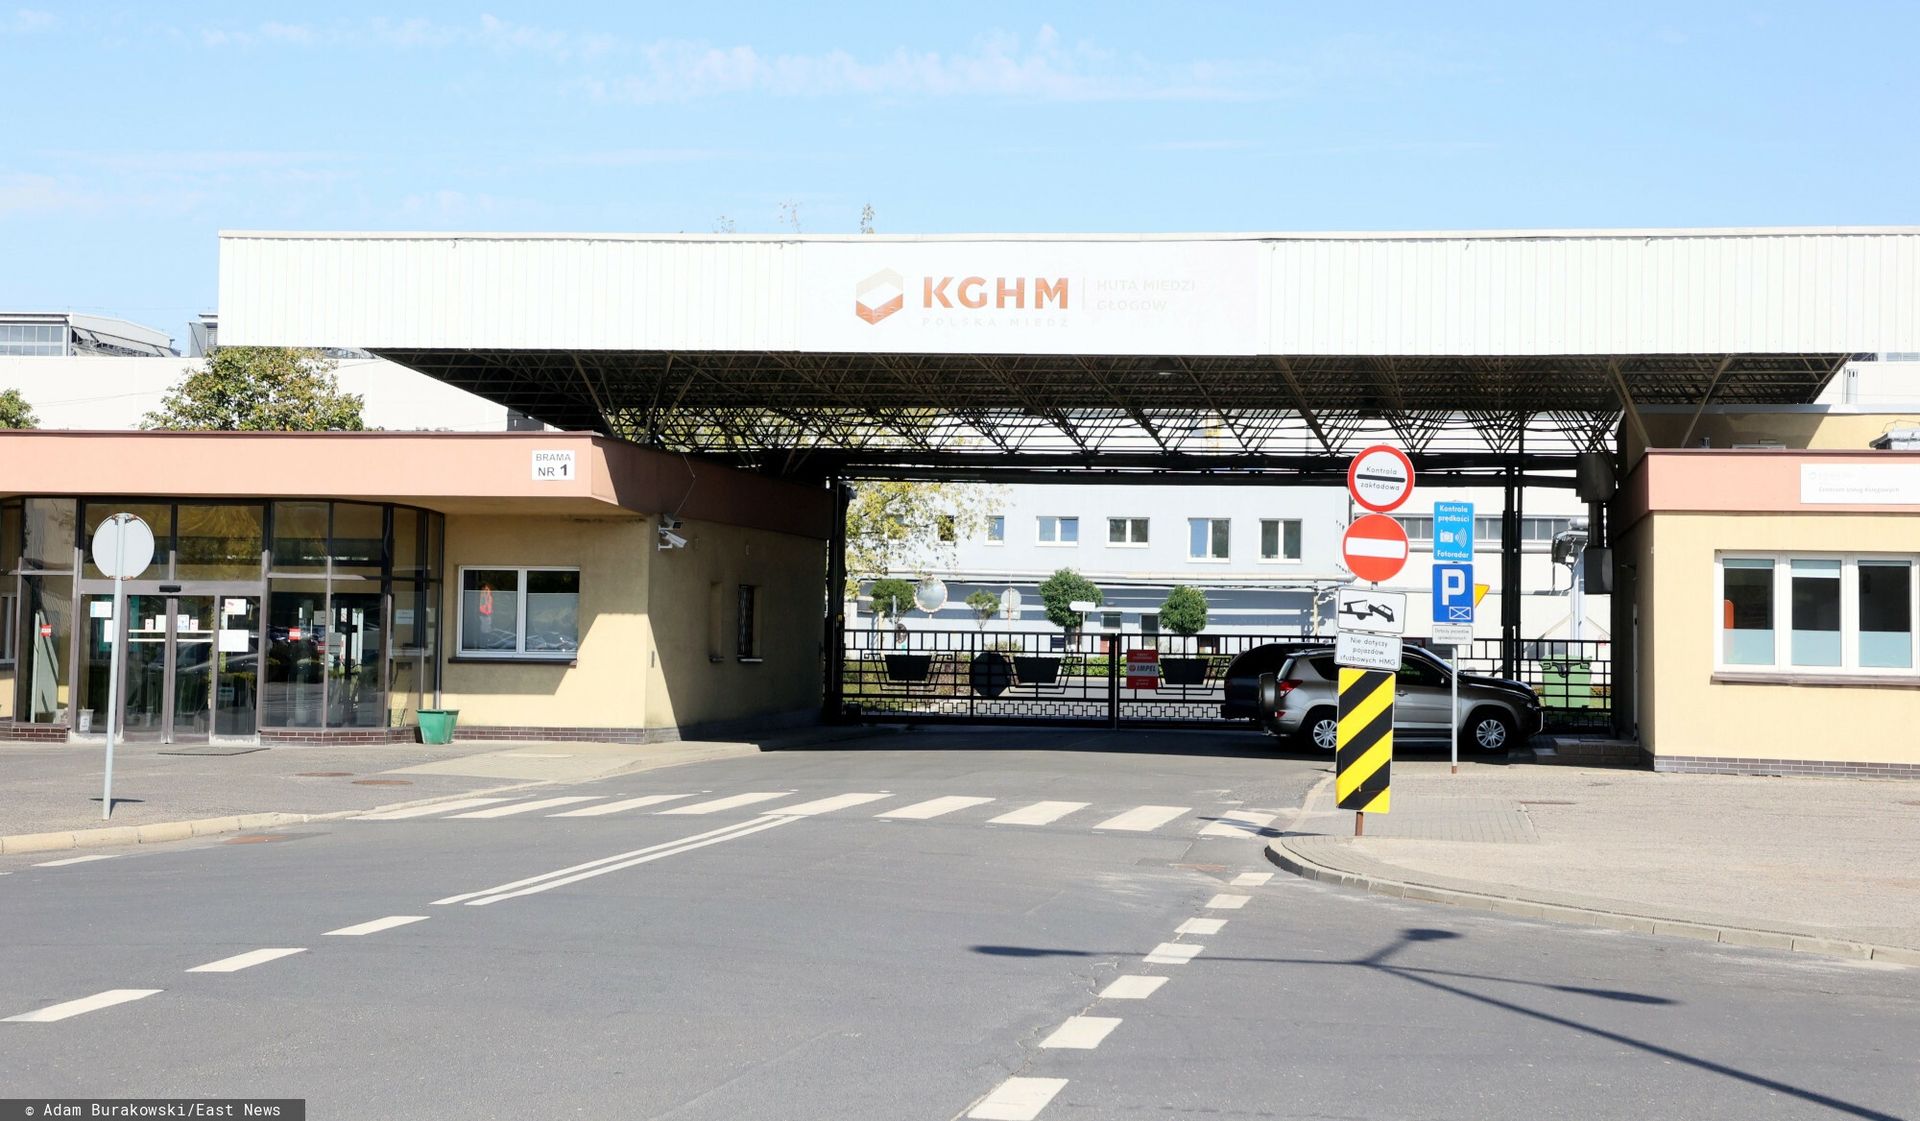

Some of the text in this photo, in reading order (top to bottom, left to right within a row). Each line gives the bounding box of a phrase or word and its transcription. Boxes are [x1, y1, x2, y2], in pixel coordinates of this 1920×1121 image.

[1096, 280, 1196, 292] HUTA MIEDZI
[922, 276, 1070, 309] KGHM
[921, 317, 998, 327] POLSKA
[535, 453, 571, 462] BRAMA
[537, 464, 567, 477] NR 1
[1366, 466, 1398, 475] Kontrola
[1360, 482, 1400, 491] zakładowa
[1439, 504, 1468, 513] Kontrola
[1438, 514, 1470, 523] prędkości
[1437, 549, 1470, 559] Fotoradar
[1441, 568, 1466, 606] P
[1363, 639, 1388, 648] dotyczy
[1352, 647, 1385, 656] pojazdów
[1378, 658, 1396, 666] HMG
[1136, 664, 1156, 672] IMPEL
